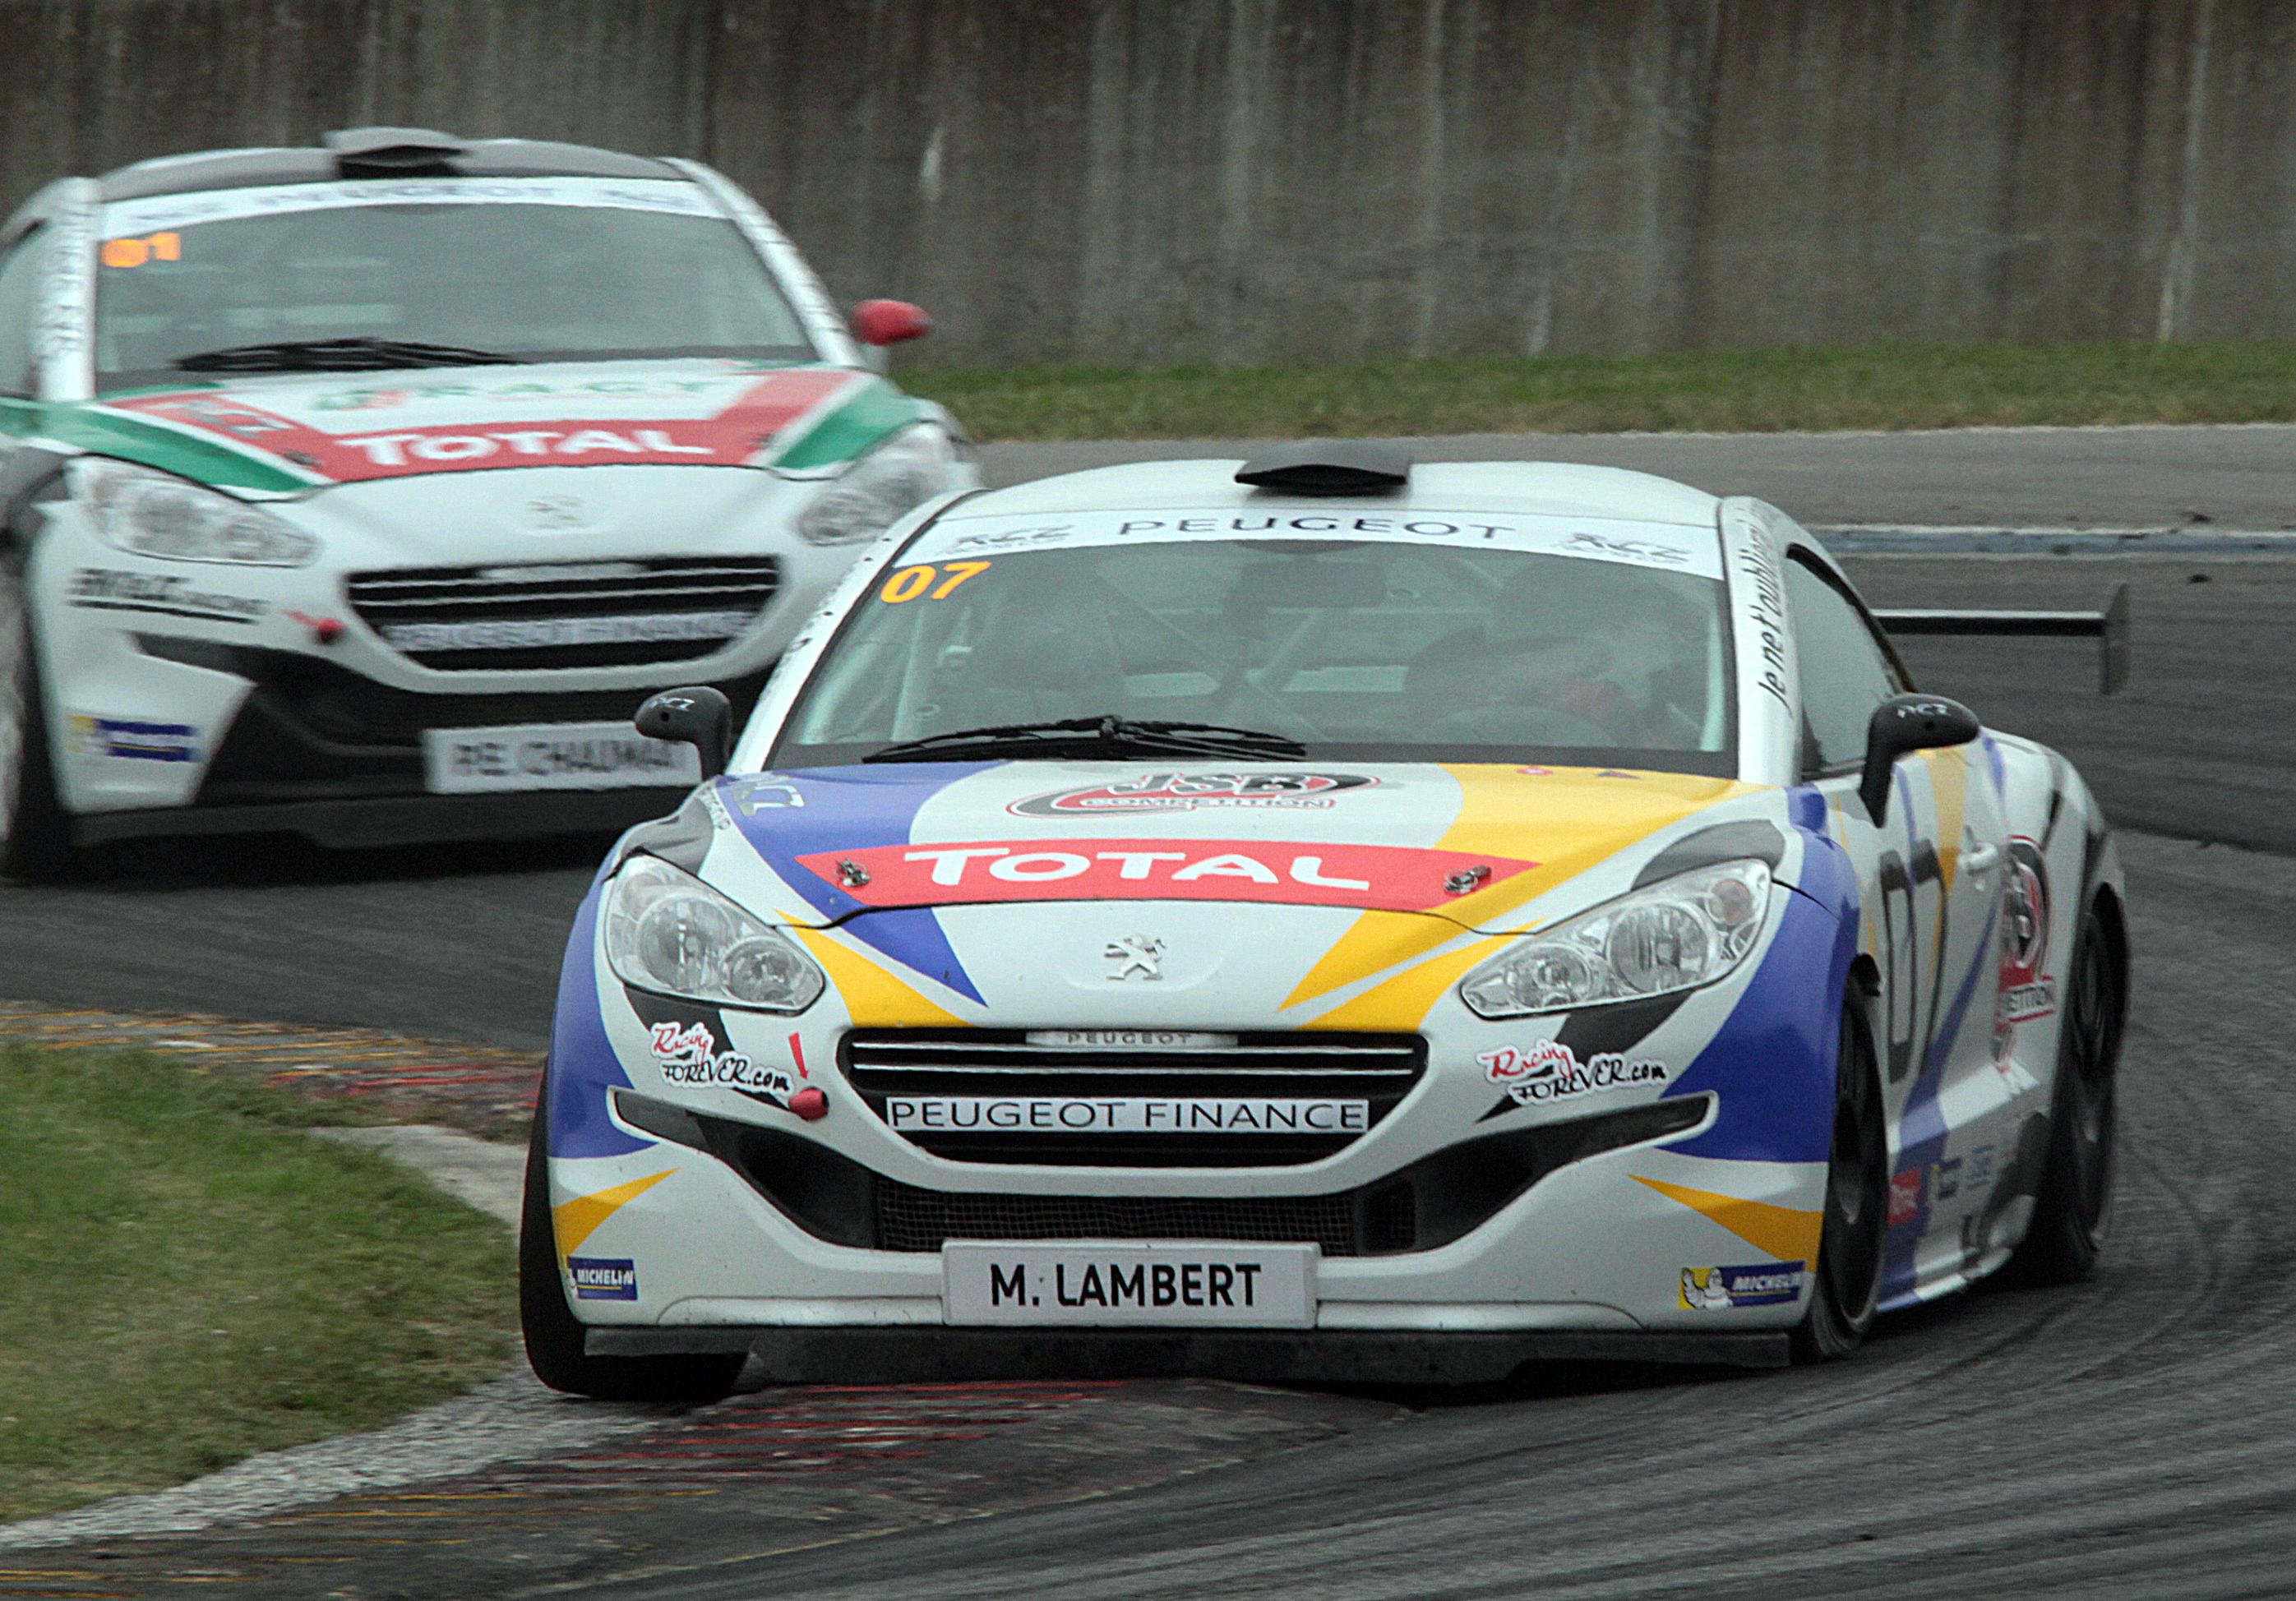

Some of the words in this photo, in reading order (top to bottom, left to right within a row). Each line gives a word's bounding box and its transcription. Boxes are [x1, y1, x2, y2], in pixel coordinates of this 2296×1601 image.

[334, 429, 715, 465] TOTAL
[1119, 516, 1516, 540] PEUGEOT
[880, 561, 992, 604] 07
[1106, 772, 1312, 796] JSB
[1081, 796, 1335, 811] COMPETITION
[905, 847, 1370, 891] TOTAL
[1068, 1030, 1191, 1045] PEUGEOT
[1482, 1042, 1573, 1080] Racing
[890, 1101, 1126, 1129] PEUGEOT
[1143, 1103, 1365, 1131] FINANCE
[577, 1268, 634, 1285] MICHELIN
[990, 1263, 1040, 1307] M.
[1055, 1263, 1262, 1307] LAMBERT
